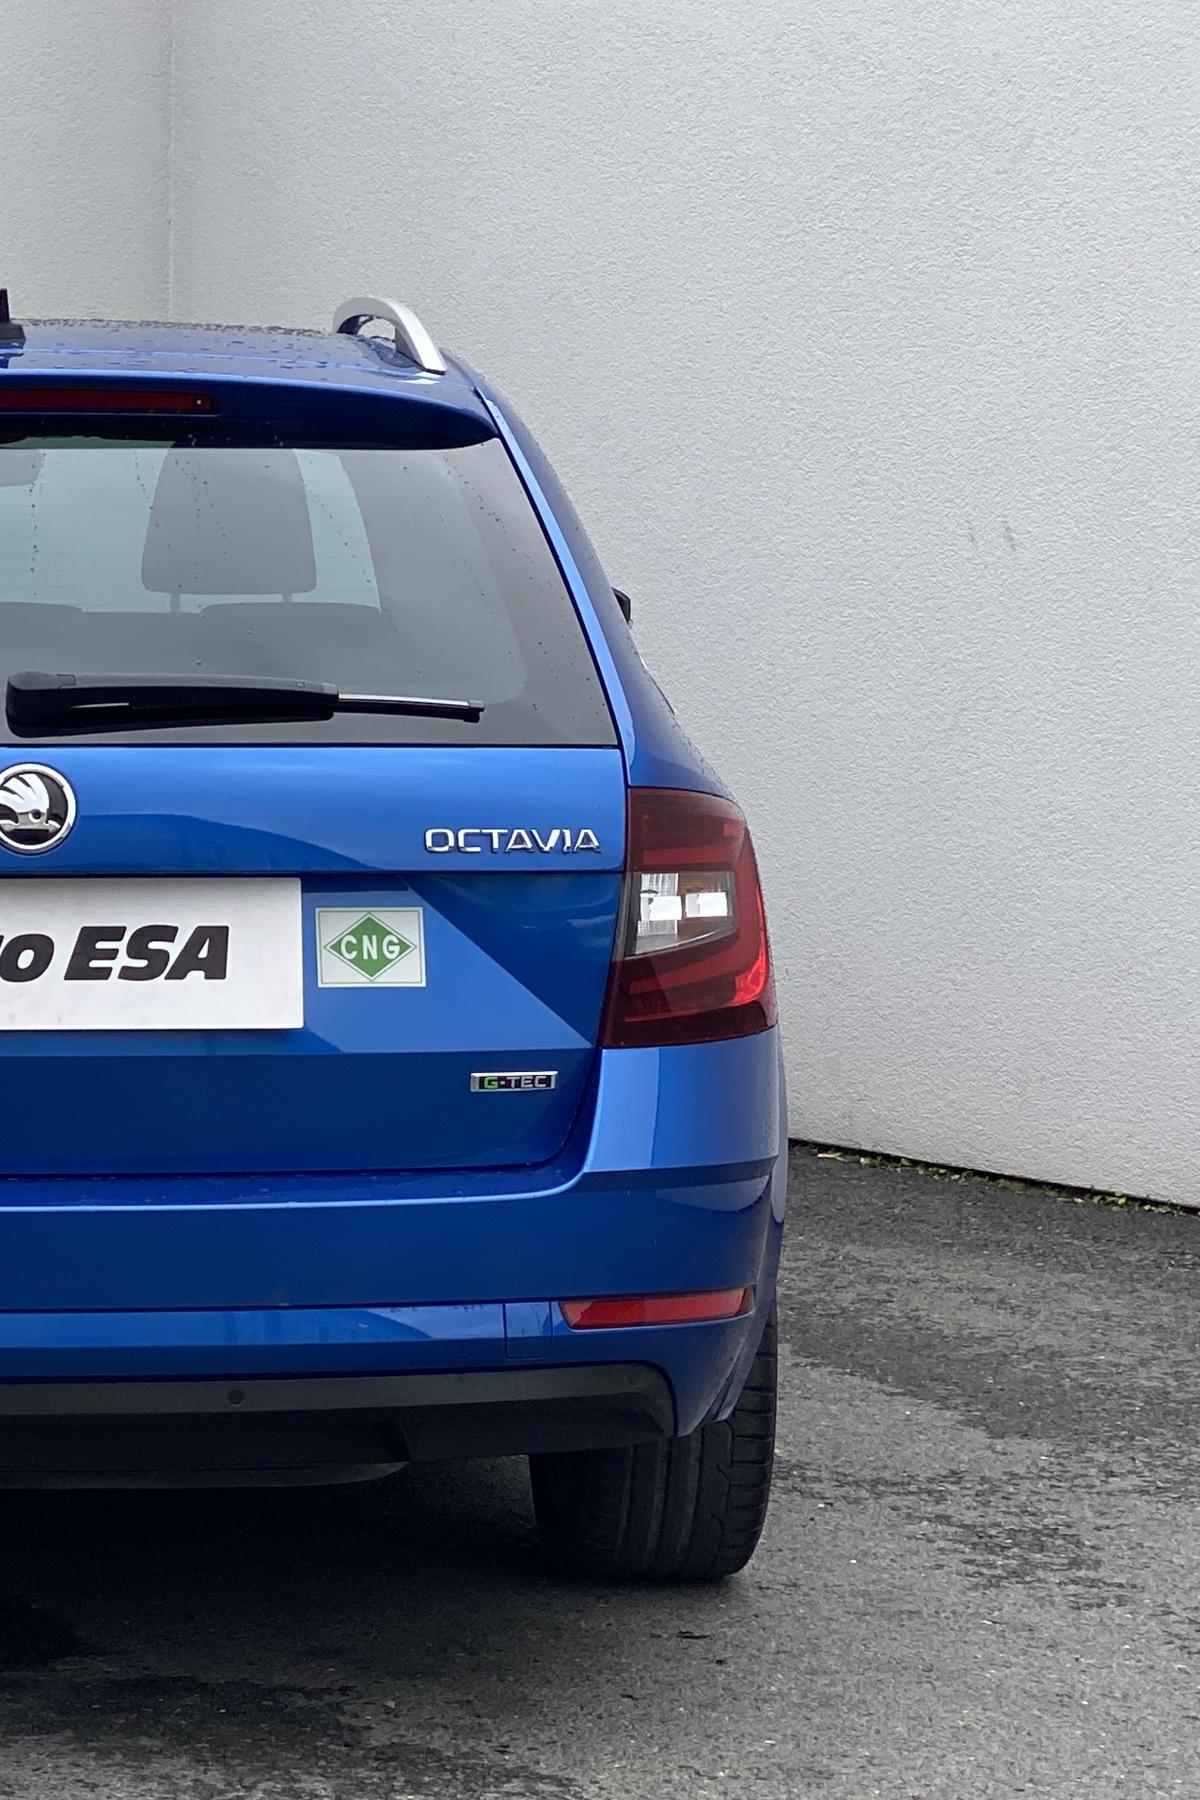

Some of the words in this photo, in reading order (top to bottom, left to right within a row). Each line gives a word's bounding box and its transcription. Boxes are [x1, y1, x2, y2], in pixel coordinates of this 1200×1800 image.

[424, 828, 601, 853] OCTAVIA
[63, 924, 230, 982] ESA
[340, 934, 401, 960] CNG
[483, 1075, 547, 1089] G-TEC
